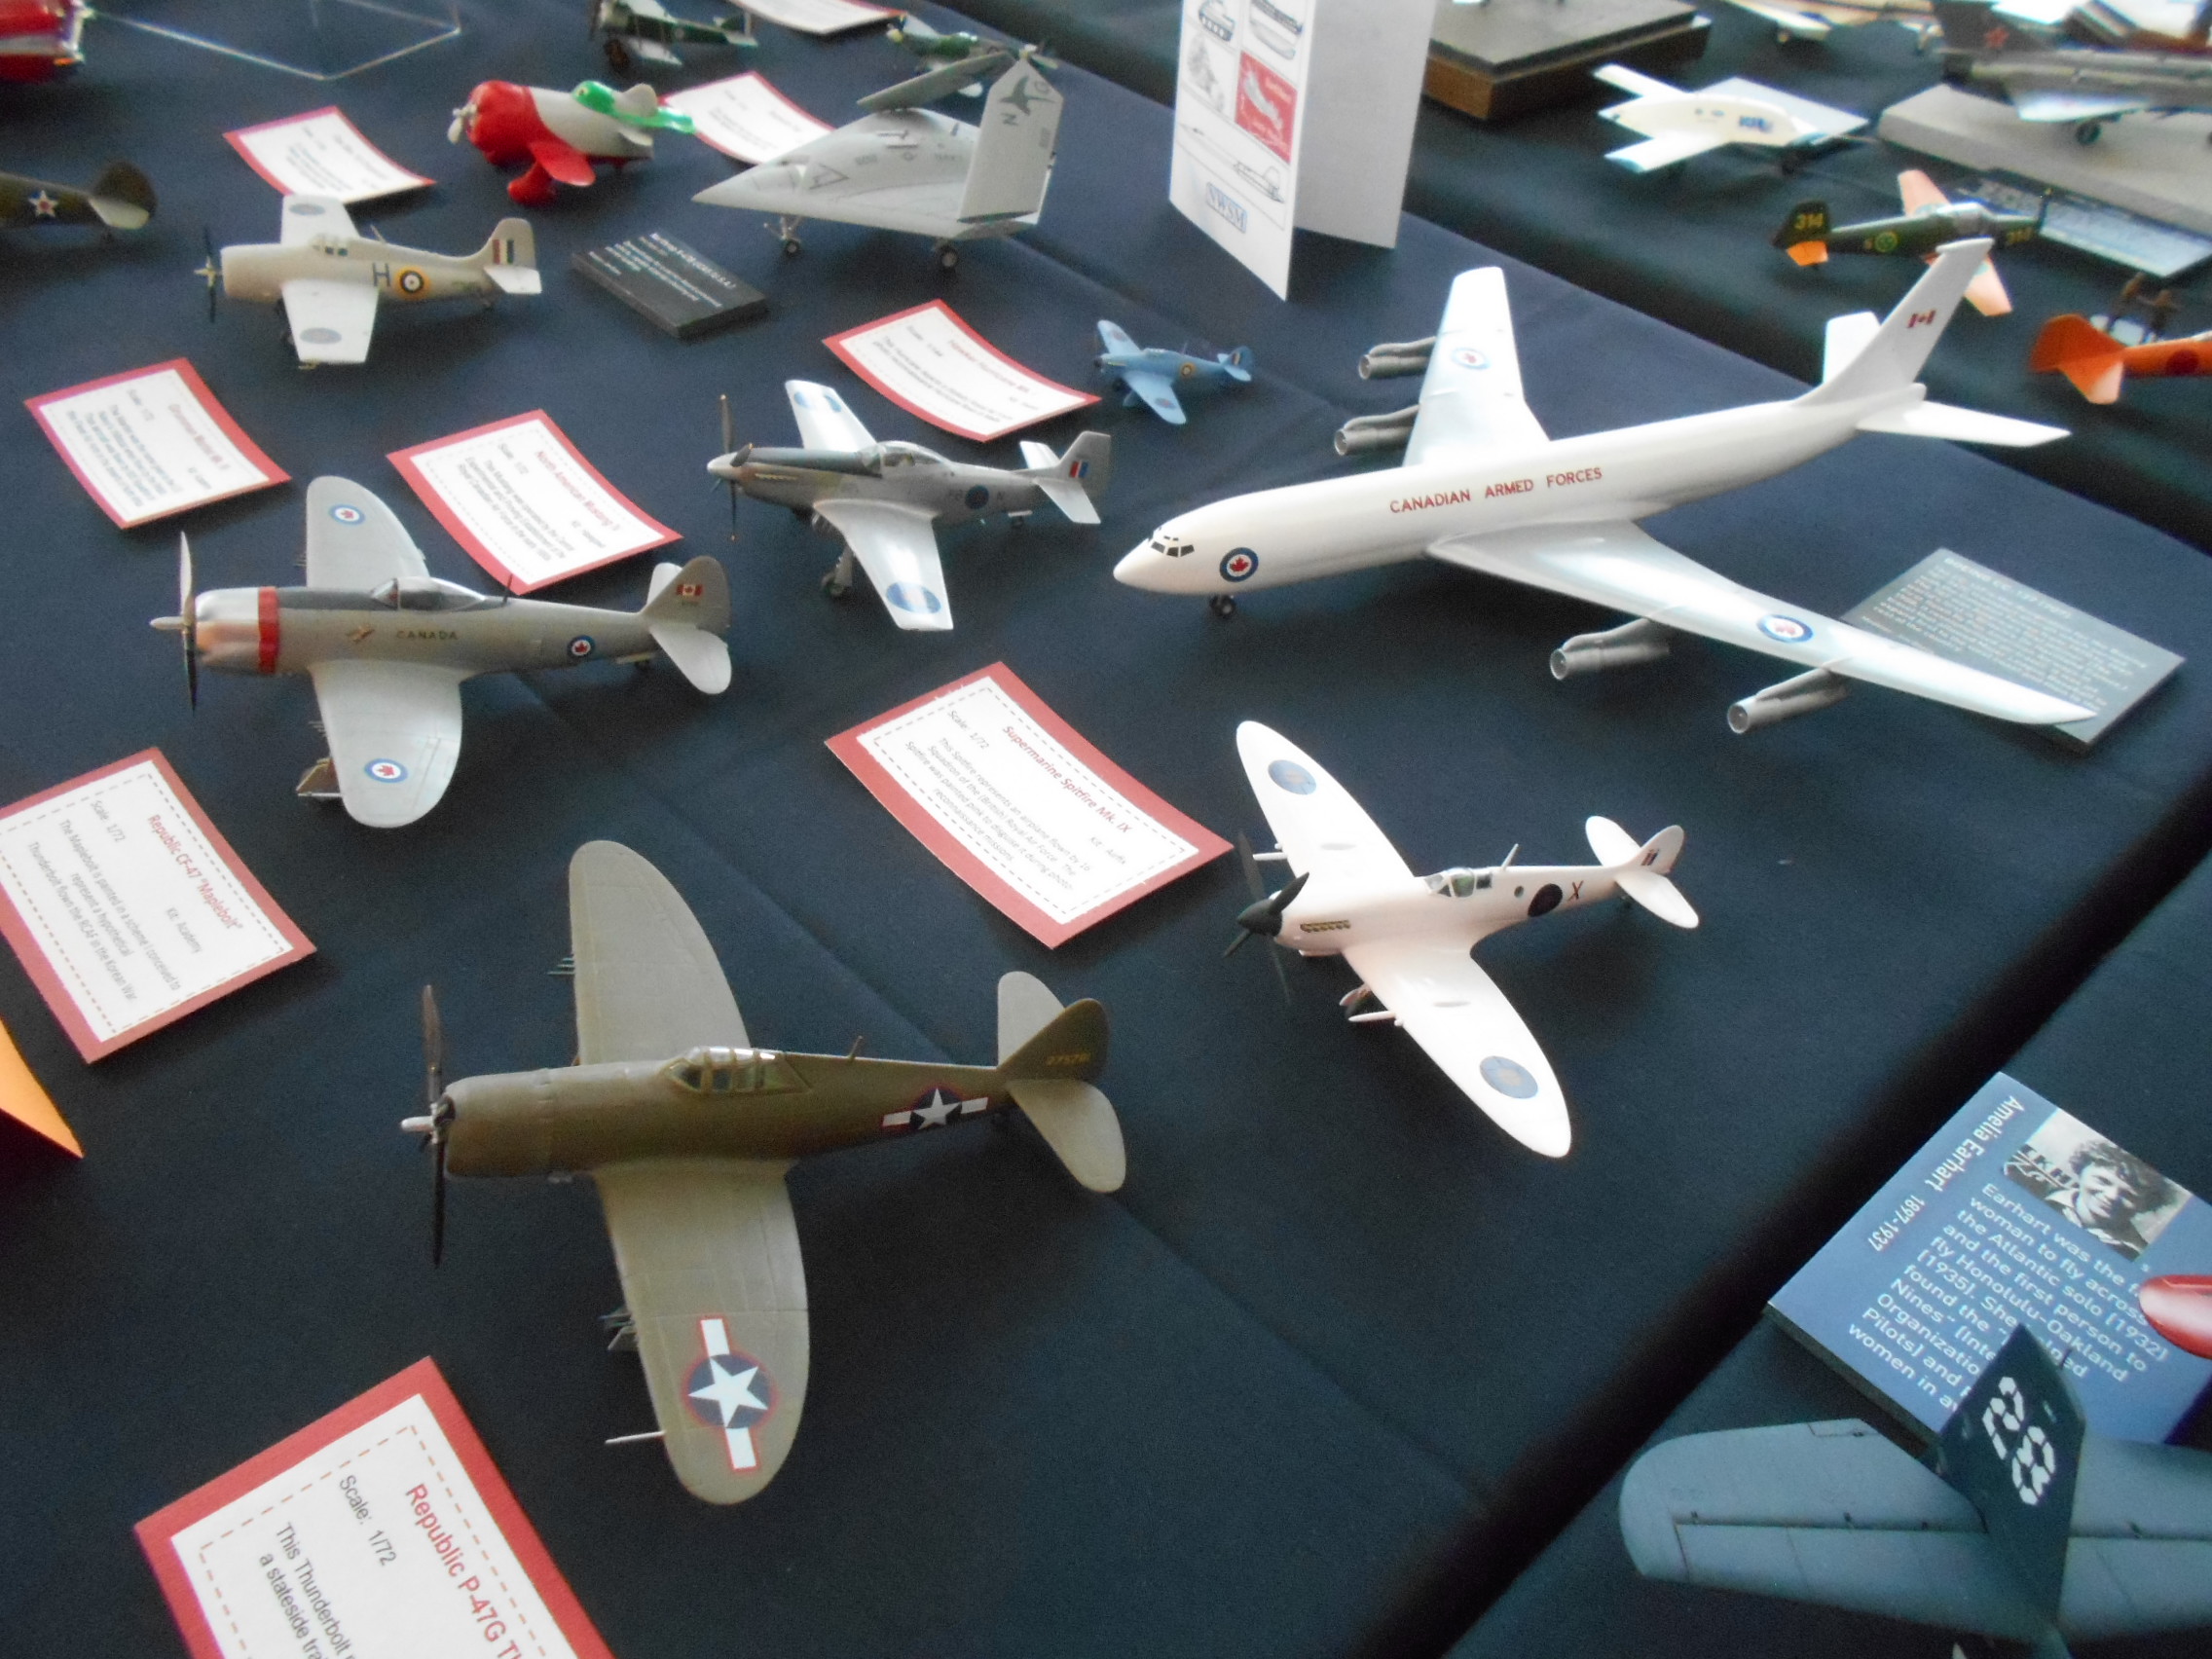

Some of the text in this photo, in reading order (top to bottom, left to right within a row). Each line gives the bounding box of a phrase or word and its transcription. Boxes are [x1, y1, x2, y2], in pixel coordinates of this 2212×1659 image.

[372, 262, 391, 287] H
[1389, 466, 1604, 513] CANADIAN ARMED FORCES
[396, 629, 459, 641] CANADA
[903, 741, 933, 765] Spitfire
[968, 731, 991, 749] 1/72
[927, 764, 945, 778] was
[940, 777, 971, 802] painted
[999, 725, 1132, 833] Supermarine Spitfire Mk. IX
[925, 745, 963, 777] Squadron
[957, 775, 971, 785] of
[966, 782, 982, 795] the
[1003, 818, 1028, 837] Royal
[1023, 834, 1040, 846] Air
[1059, 863, 1079, 877] The
[931, 787, 986, 835] reconnaissance
[936, 737, 957, 753] This
[948, 750, 979, 775] Spitfire
[972, 772, 1013, 807] represents
[1009, 805, 1022, 816] an
[1017, 813, 1051, 840] airplane
[1047, 837, 1073, 858] flown
[1066, 854, 1082, 865] by
[965, 800, 986, 817] pink
[981, 814, 995, 825] to
[105, 823, 126, 843] 1/72
[145, 814, 183, 856] Republic
[174, 852, 202, 880] CF-47
[988, 822, 1022, 850] disguise
[1017, 845, 1030, 854] it
[27, 840, 62, 889] Thunderbolt
[1023, 851, 1052, 874] during
[55, 884, 75, 909] flown
[58, 819, 75, 835] The
[67, 832, 99, 873] Maplebolt
[94, 876, 122, 907] painted
[116, 903, 129, 914] in
[125, 916, 150, 947] scheme
[145, 946, 175, 985] conceived
[168, 980, 181, 991] to
[1567, 879, 1584, 903] X
[68, 870, 98, 909] represent
[95, 910, 132, 959] hypothetical
[69, 905, 84, 921] the
[77, 918, 97, 941] RCAF
[91, 938, 101, 947] in
[94, 945, 111, 961] the
[174, 920, 203, 955] Academy
[103, 958, 128, 988] Korean
[1923, 1094, 2028, 1194] Amelia Earhart
[1862, 1193, 1927, 1252] 1897-1937
[1978, 1182, 2129, 1286] Earhart was the
[1954, 1209, 1990, 1235] the
[1983, 1231, 2065, 1286] Atlantic
[2059, 1282, 2107, 1316] solo
[1964, 1196, 2039, 1246] woman
[2035, 1242, 2060, 1262] to
[2055, 1257, 2087, 1282] fly
[2082, 1275, 2156, 1327] across
[1898, 1264, 1995, 1333] found the
[1926, 1236, 2138, 1382] fly Honolulu-Oakland
[1938, 1222, 1981, 1252] and
[1977, 1248, 2015, 1276] the
[2010, 1271, 2058, 1306] first
[2049, 1302, 2120, 1351] person
[2122, 1349, 2151, 1373] to
[1976, 1294, 2023, 1329] She
[1866, 1291, 1992, 1377] Organizatio
[1839, 1323, 1942, 1396] women in
[1918, 1353, 1965, 1387] and
[335, 1474, 398, 1567] Scale: 1/72
[258, 1552, 275, 1567] a
[399, 1483, 474, 1578] Republic
[455, 1575, 510, 1642] P-47G
[261, 1567, 316, 1640] stateside
[272, 1522, 358, 1655] This Thunderbolt
